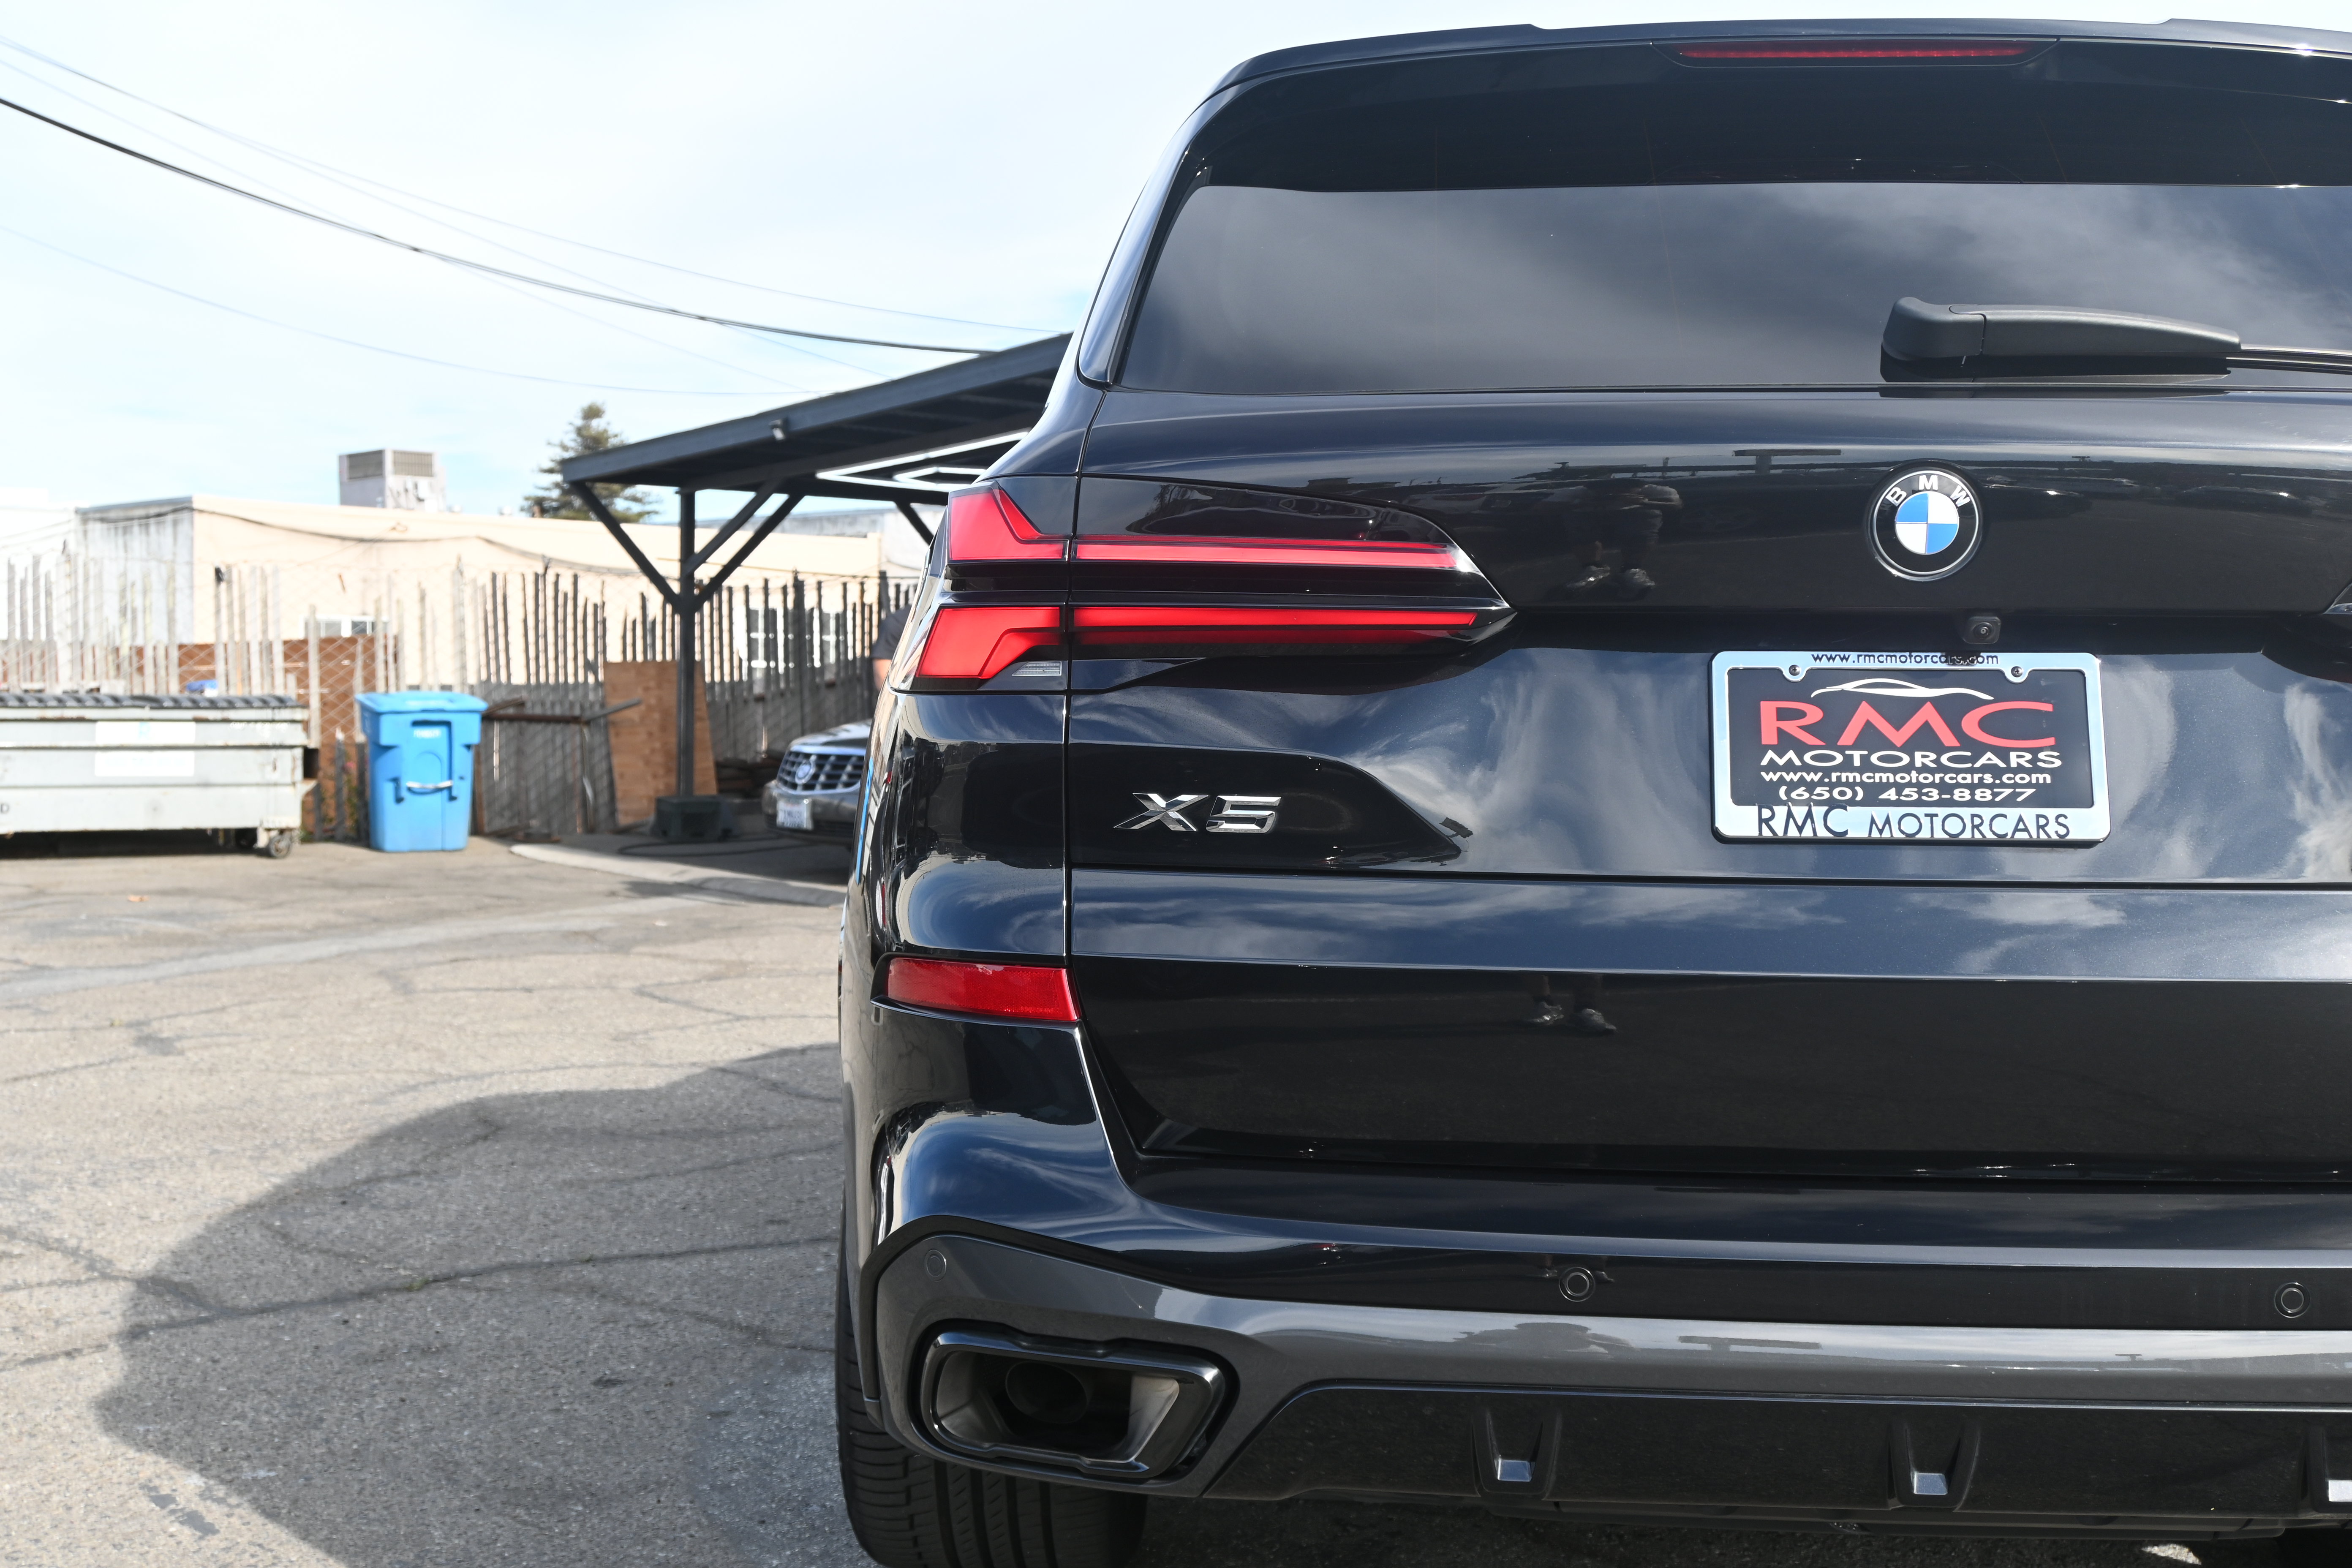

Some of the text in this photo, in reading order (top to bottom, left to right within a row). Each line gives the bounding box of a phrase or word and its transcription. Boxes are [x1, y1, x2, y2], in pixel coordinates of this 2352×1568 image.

[1886, 475, 1970, 506] BMW
[1812, 653, 1999, 664] www.rmcmotorcars.com
[1760, 701, 2055, 748] RMC
[1760, 750, 2062, 768] MOTORCARS
[1761, 770, 2051, 784] www.rmcmotorcars.com
[1779, 786, 2036, 801] (650) 453-8877
[1113, 793, 1281, 833] X5
[1757, 802, 2070, 838] RMC MOTORCARS
